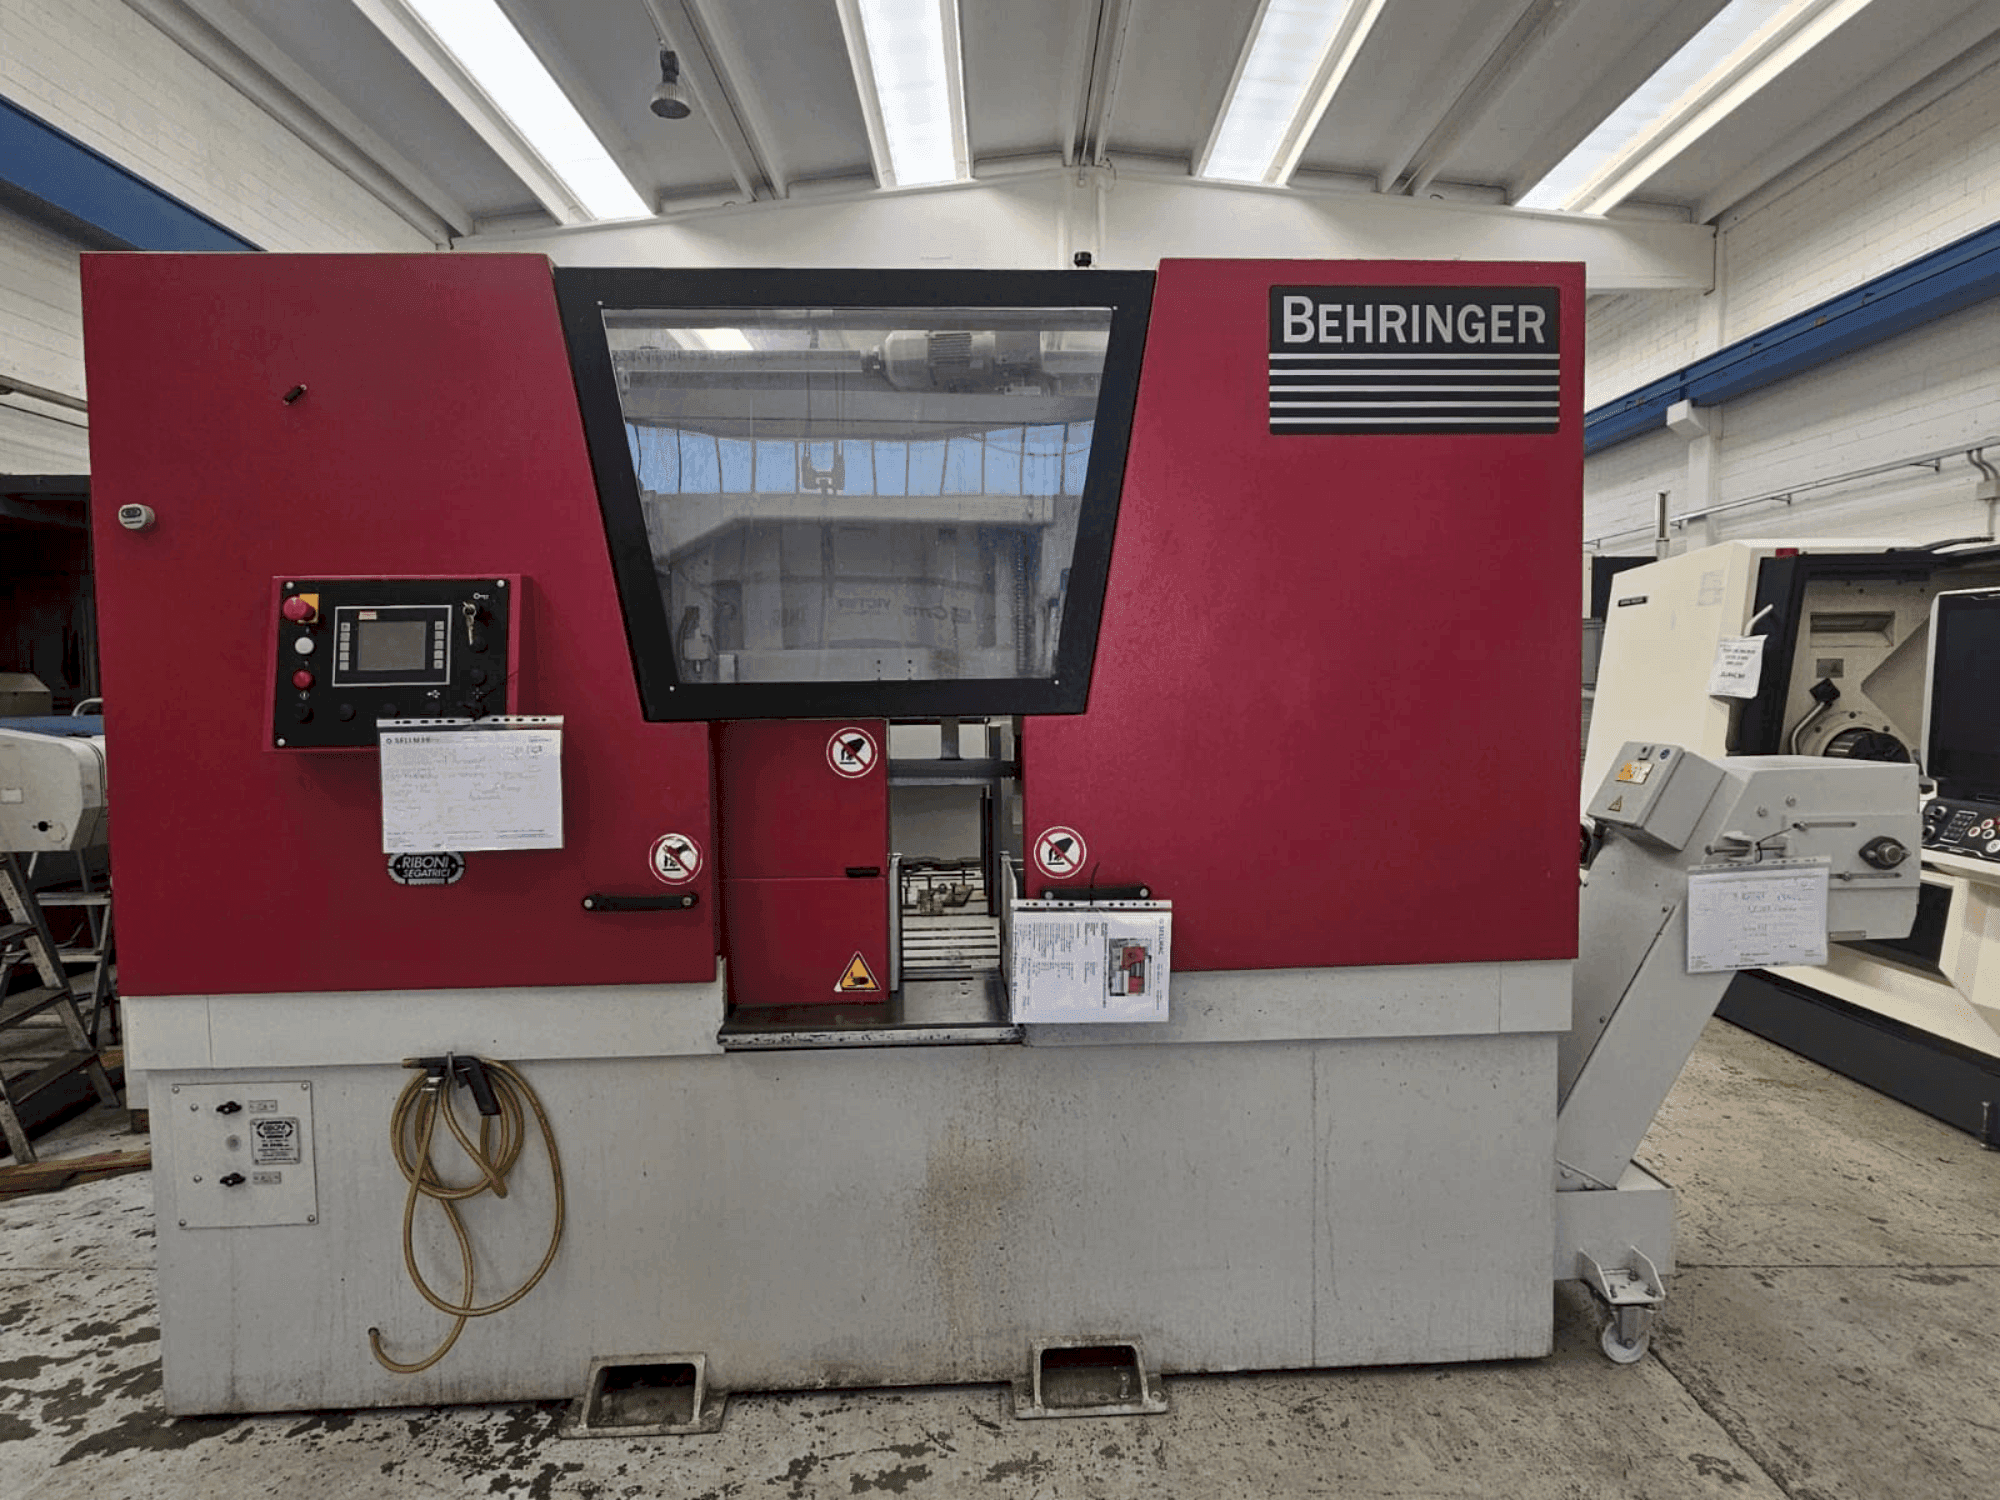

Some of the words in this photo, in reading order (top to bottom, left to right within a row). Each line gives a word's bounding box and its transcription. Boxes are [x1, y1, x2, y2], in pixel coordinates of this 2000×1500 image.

[1283, 295, 1546, 344] BEHRINGER
[402, 855, 449, 869] RIBONI
[402, 869, 451, 877] SEGATRICI
